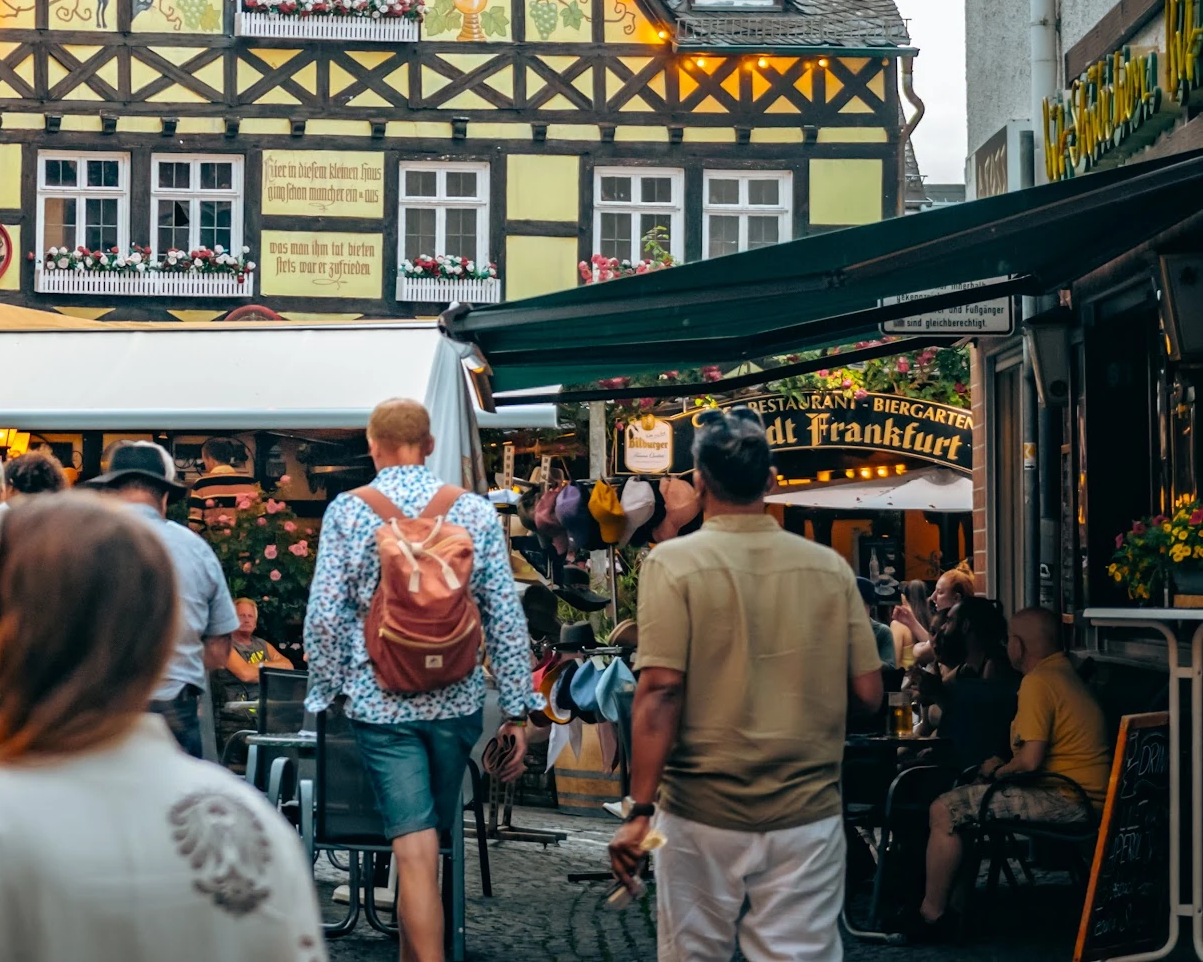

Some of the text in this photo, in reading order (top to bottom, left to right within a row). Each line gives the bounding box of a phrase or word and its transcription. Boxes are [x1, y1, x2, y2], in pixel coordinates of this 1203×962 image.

[329, 163, 359, 180] kleinen
[346, 187, 358, 202] ein
[364, 190, 379, 203] aus
[270, 242, 288, 254] was
[290, 243, 309, 255] man
[312, 240, 328, 257] ihm
[348, 242, 375, 257] bieten
[299, 261, 317, 274] war
[318, 261, 327, 274] er
[965, 305, 1004, 316] Fußgänger
[907, 319, 922, 327] sind
[628, 437, 669, 451] Bitburger
[805, 412, 963, 461] Frankfurt
